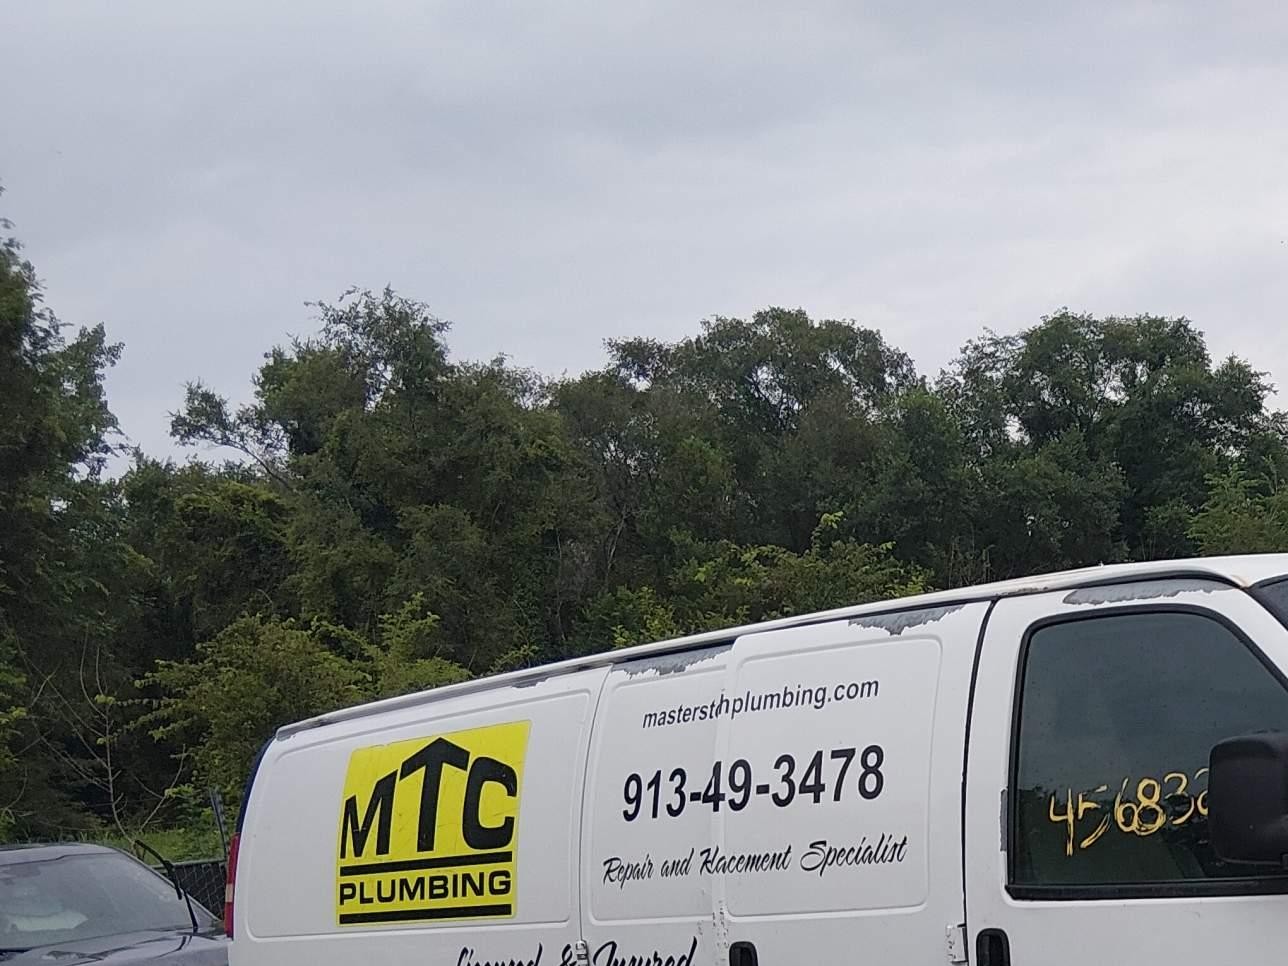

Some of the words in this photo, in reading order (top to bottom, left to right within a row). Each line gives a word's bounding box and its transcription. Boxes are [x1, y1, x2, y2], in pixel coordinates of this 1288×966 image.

[340, 737, 518, 859] MTC
[623, 744, 885, 823] 913-49-3478
[339, 869, 512, 906] PLUMBING
[603, 854, 655, 889] Repair
[660, 847, 695, 877] and
[800, 832, 908, 877] Specialist
